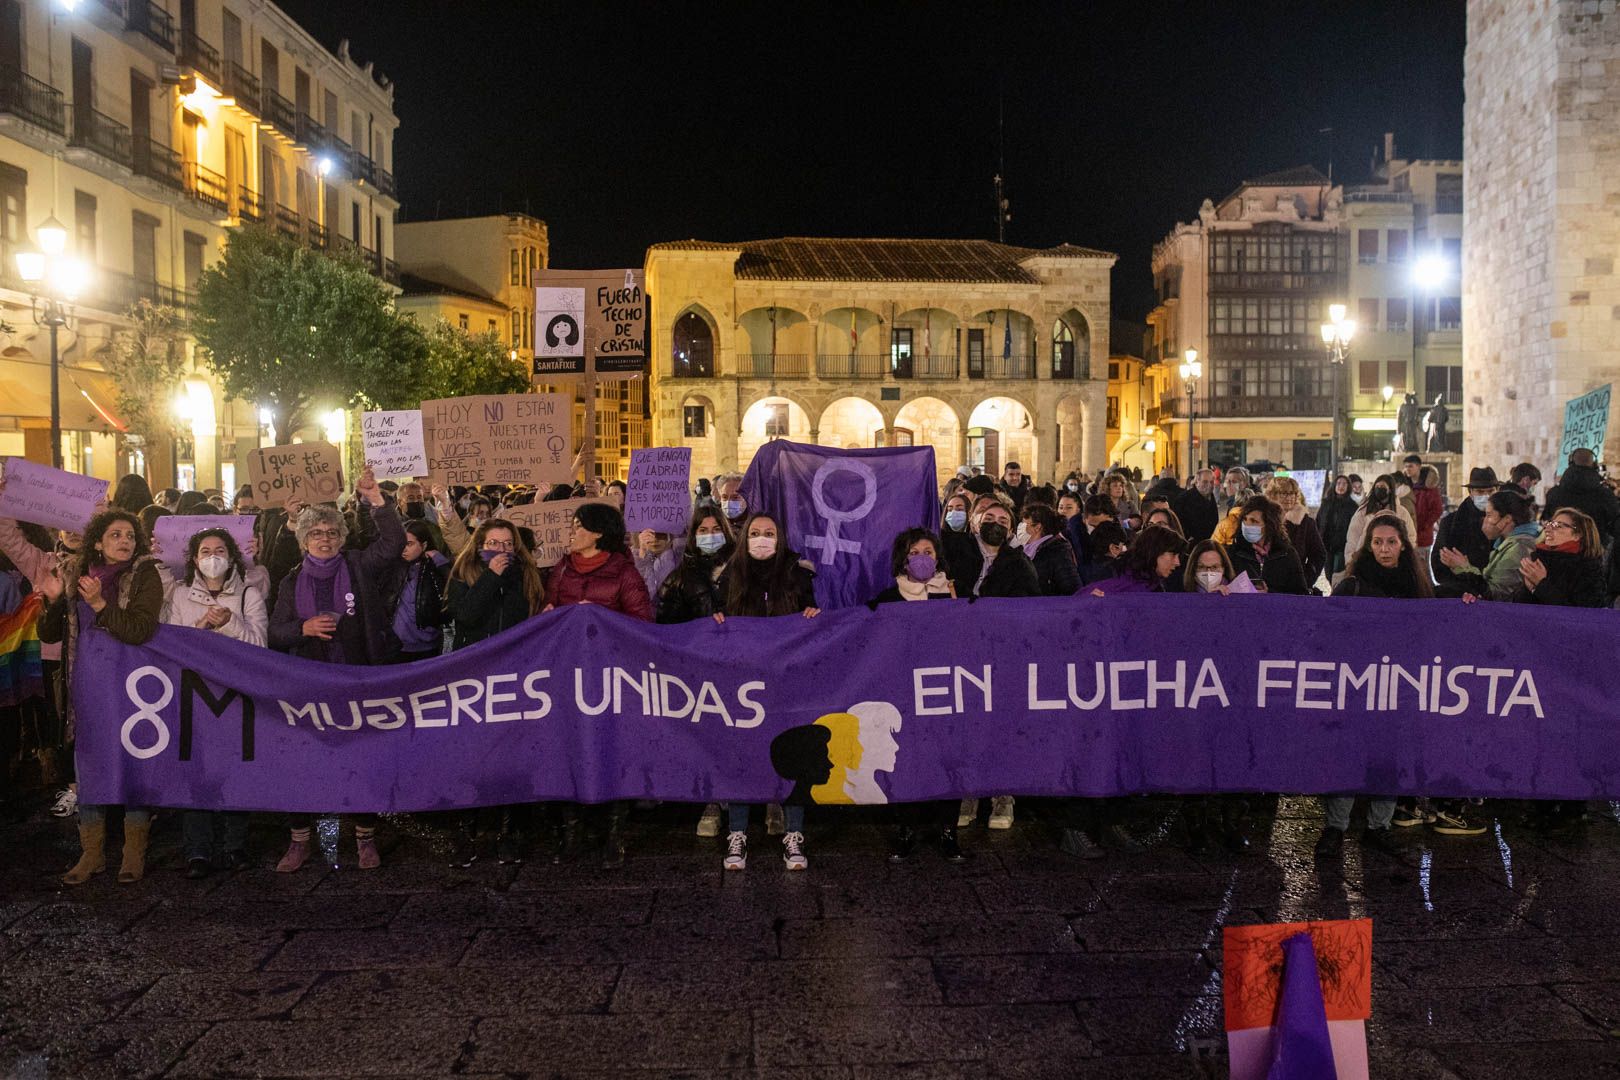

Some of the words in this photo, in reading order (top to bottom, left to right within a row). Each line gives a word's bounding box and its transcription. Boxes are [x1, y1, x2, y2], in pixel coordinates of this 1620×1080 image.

[597, 286, 641, 307] FUERA
[601, 306, 642, 322] TECHO
[615, 323, 632, 337] DE
[537, 361, 577, 370] SANTAFIXIE
[436, 403, 473, 424] HOY
[484, 401, 504, 423] NO
[516, 398, 555, 418] ESTÁN
[1568, 390, 1610, 421] MANOLO
[380, 416, 395, 428] MI
[428, 426, 472, 441] TODAS
[489, 422, 554, 437] NUESTRAS
[440, 441, 481, 457] VOCES
[493, 439, 537, 451] PORQUE
[1563, 435, 1590, 455] CENA
[1593, 430, 1605, 444] TU
[302, 451, 321, 466] te
[429, 458, 467, 470] DESDE
[475, 457, 486, 467] LA
[493, 457, 523, 466] TUMBA
[529, 456, 542, 465] NO
[551, 454, 561, 464] SE
[635, 451, 653, 464] QUE
[657, 450, 689, 462] VENGAN
[272, 473, 302, 494] dije
[305, 462, 329, 479] que
[446, 469, 485, 484] PUEDE
[632, 466, 640, 476] A
[629, 479, 650, 490] QUE
[629, 493, 648, 502] LES
[652, 492, 680, 504] VAMOS
[509, 511, 541, 526] SALE
[628, 506, 636, 521] A
[640, 506, 684, 523] MORDER
[545, 527, 563, 544] QUE
[121, 665, 255, 762] 8M
[277, 669, 552, 731] MUJERES
[913, 664, 993, 716] EN
[1028, 658, 1231, 711] LUCHA
